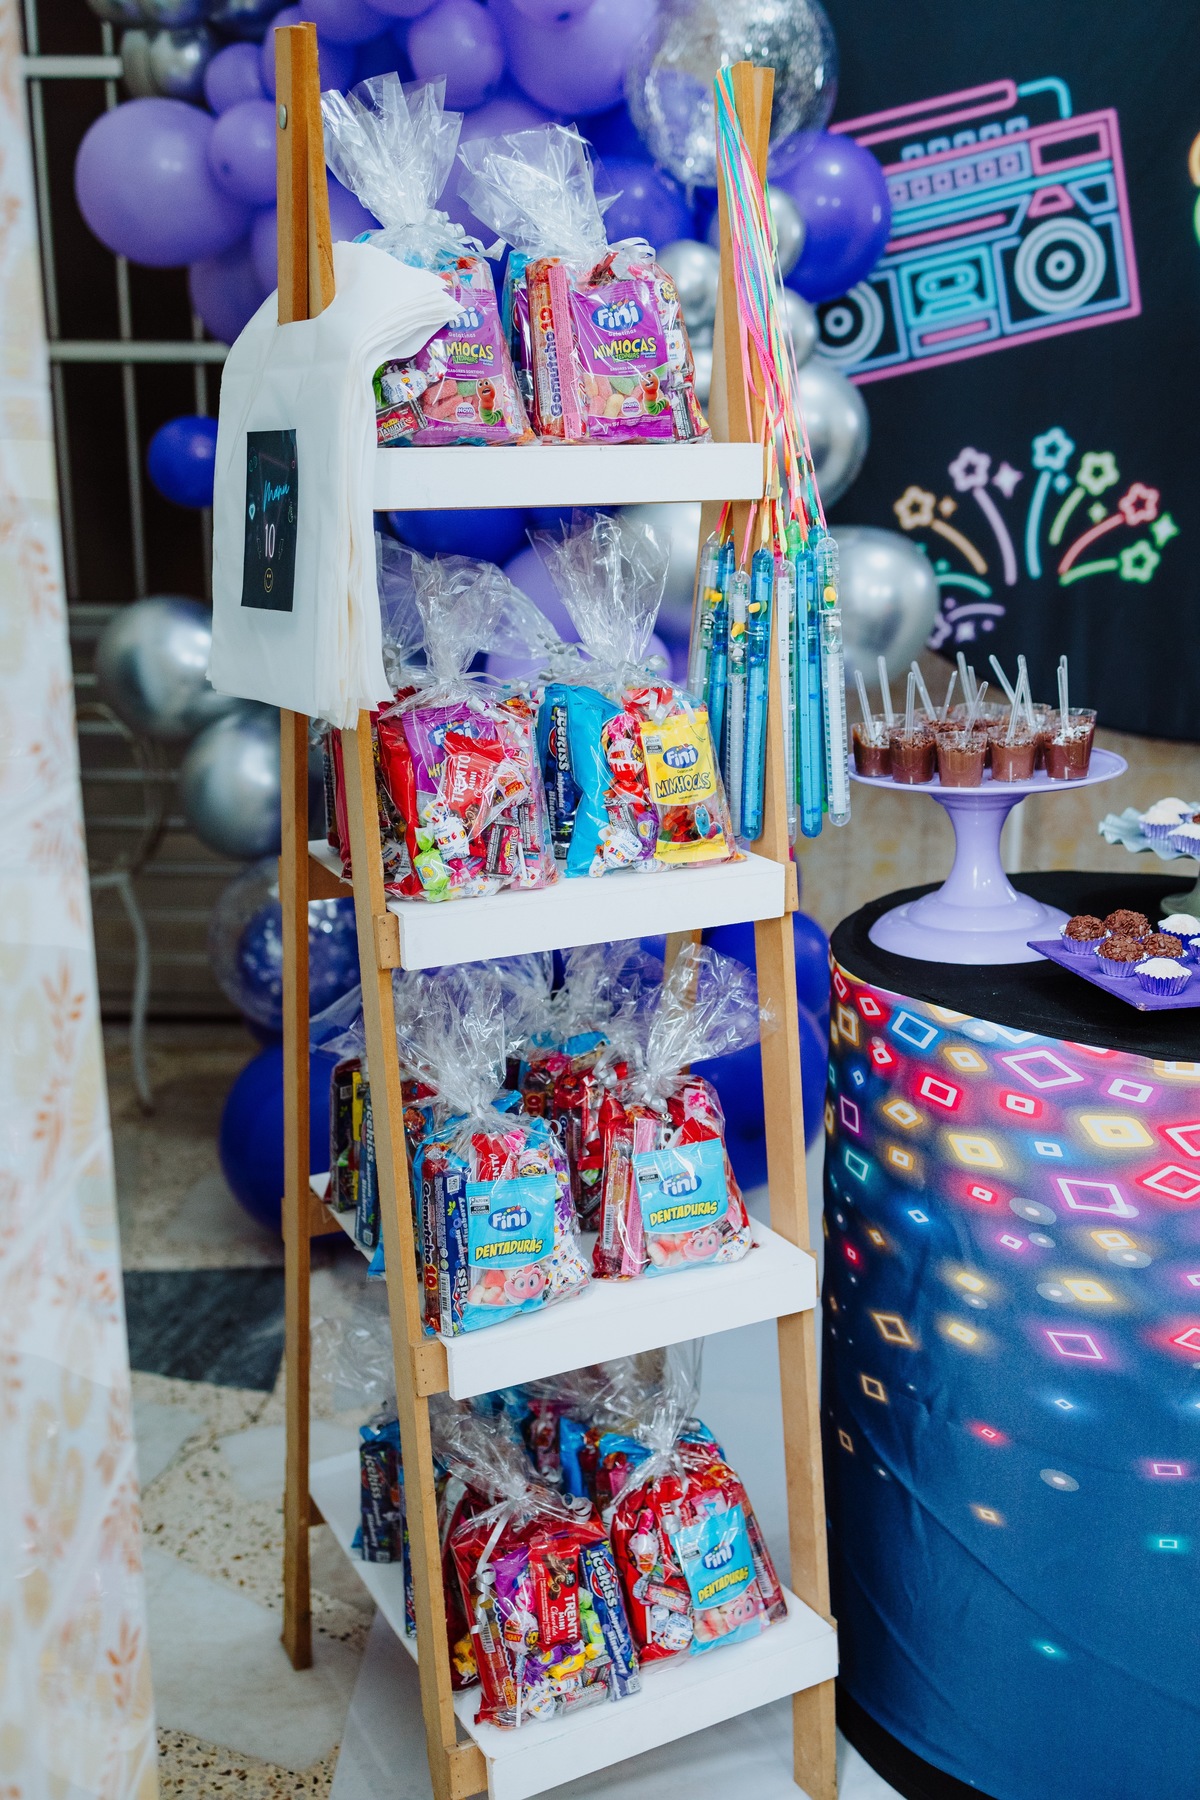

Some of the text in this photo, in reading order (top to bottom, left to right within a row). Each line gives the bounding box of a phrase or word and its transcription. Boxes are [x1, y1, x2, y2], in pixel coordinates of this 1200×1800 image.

[449, 307, 479, 328] ni
[597, 301, 639, 328] Fini
[594, 336, 657, 360] MINHOCAS
[545, 331, 562, 416] Gomutcho
[265, 523, 275, 558] 10
[666, 746, 697, 767] Fini
[452, 754, 471, 803] TRENTO
[469, 771, 478, 790] MINI
[655, 772, 711, 798] MINHOCAS
[663, 1177, 697, 1195] Fini
[492, 1207, 527, 1229] Fini
[649, 1201, 718, 1227] DENTADURAS
[423, 1182, 437, 1289] Gomutcho 10
[475, 1239, 544, 1262] DENTADURAS
[704, 1543, 732, 1568] Fini
[590, 1551, 617, 1608] icekiss
[697, 1565, 749, 1604] DENTADURAS
[607, 1631, 628, 1674] Blueberry
